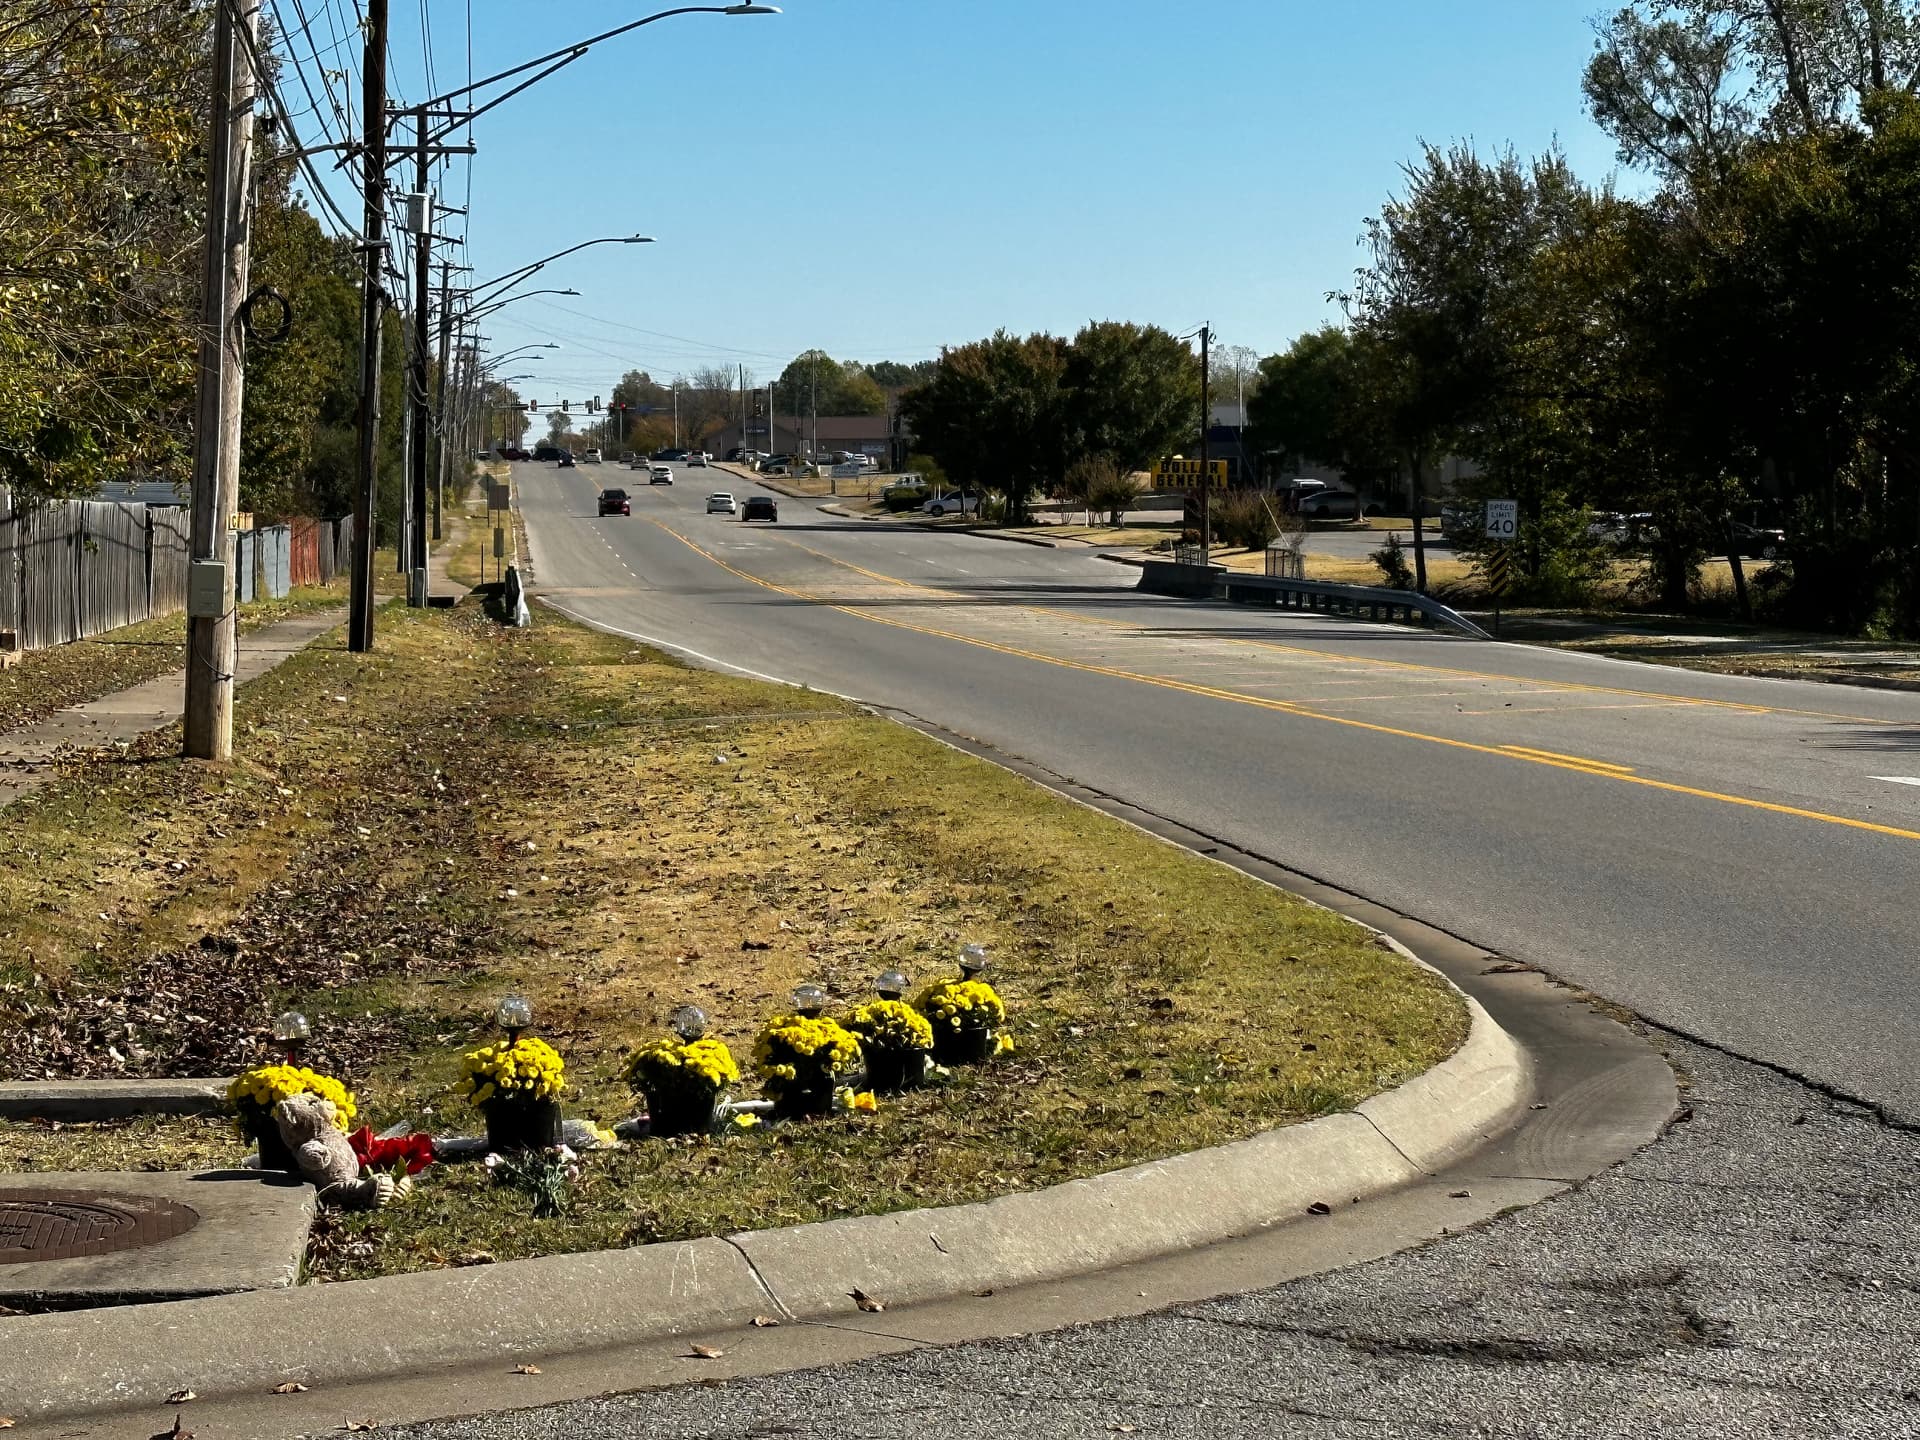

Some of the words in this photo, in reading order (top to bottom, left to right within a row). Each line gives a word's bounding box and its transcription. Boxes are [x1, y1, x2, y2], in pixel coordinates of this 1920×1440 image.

[1161, 462, 1218, 473] DOLLR
[1489, 503, 1515, 511] SPEED
[1488, 520, 1514, 533] 40
